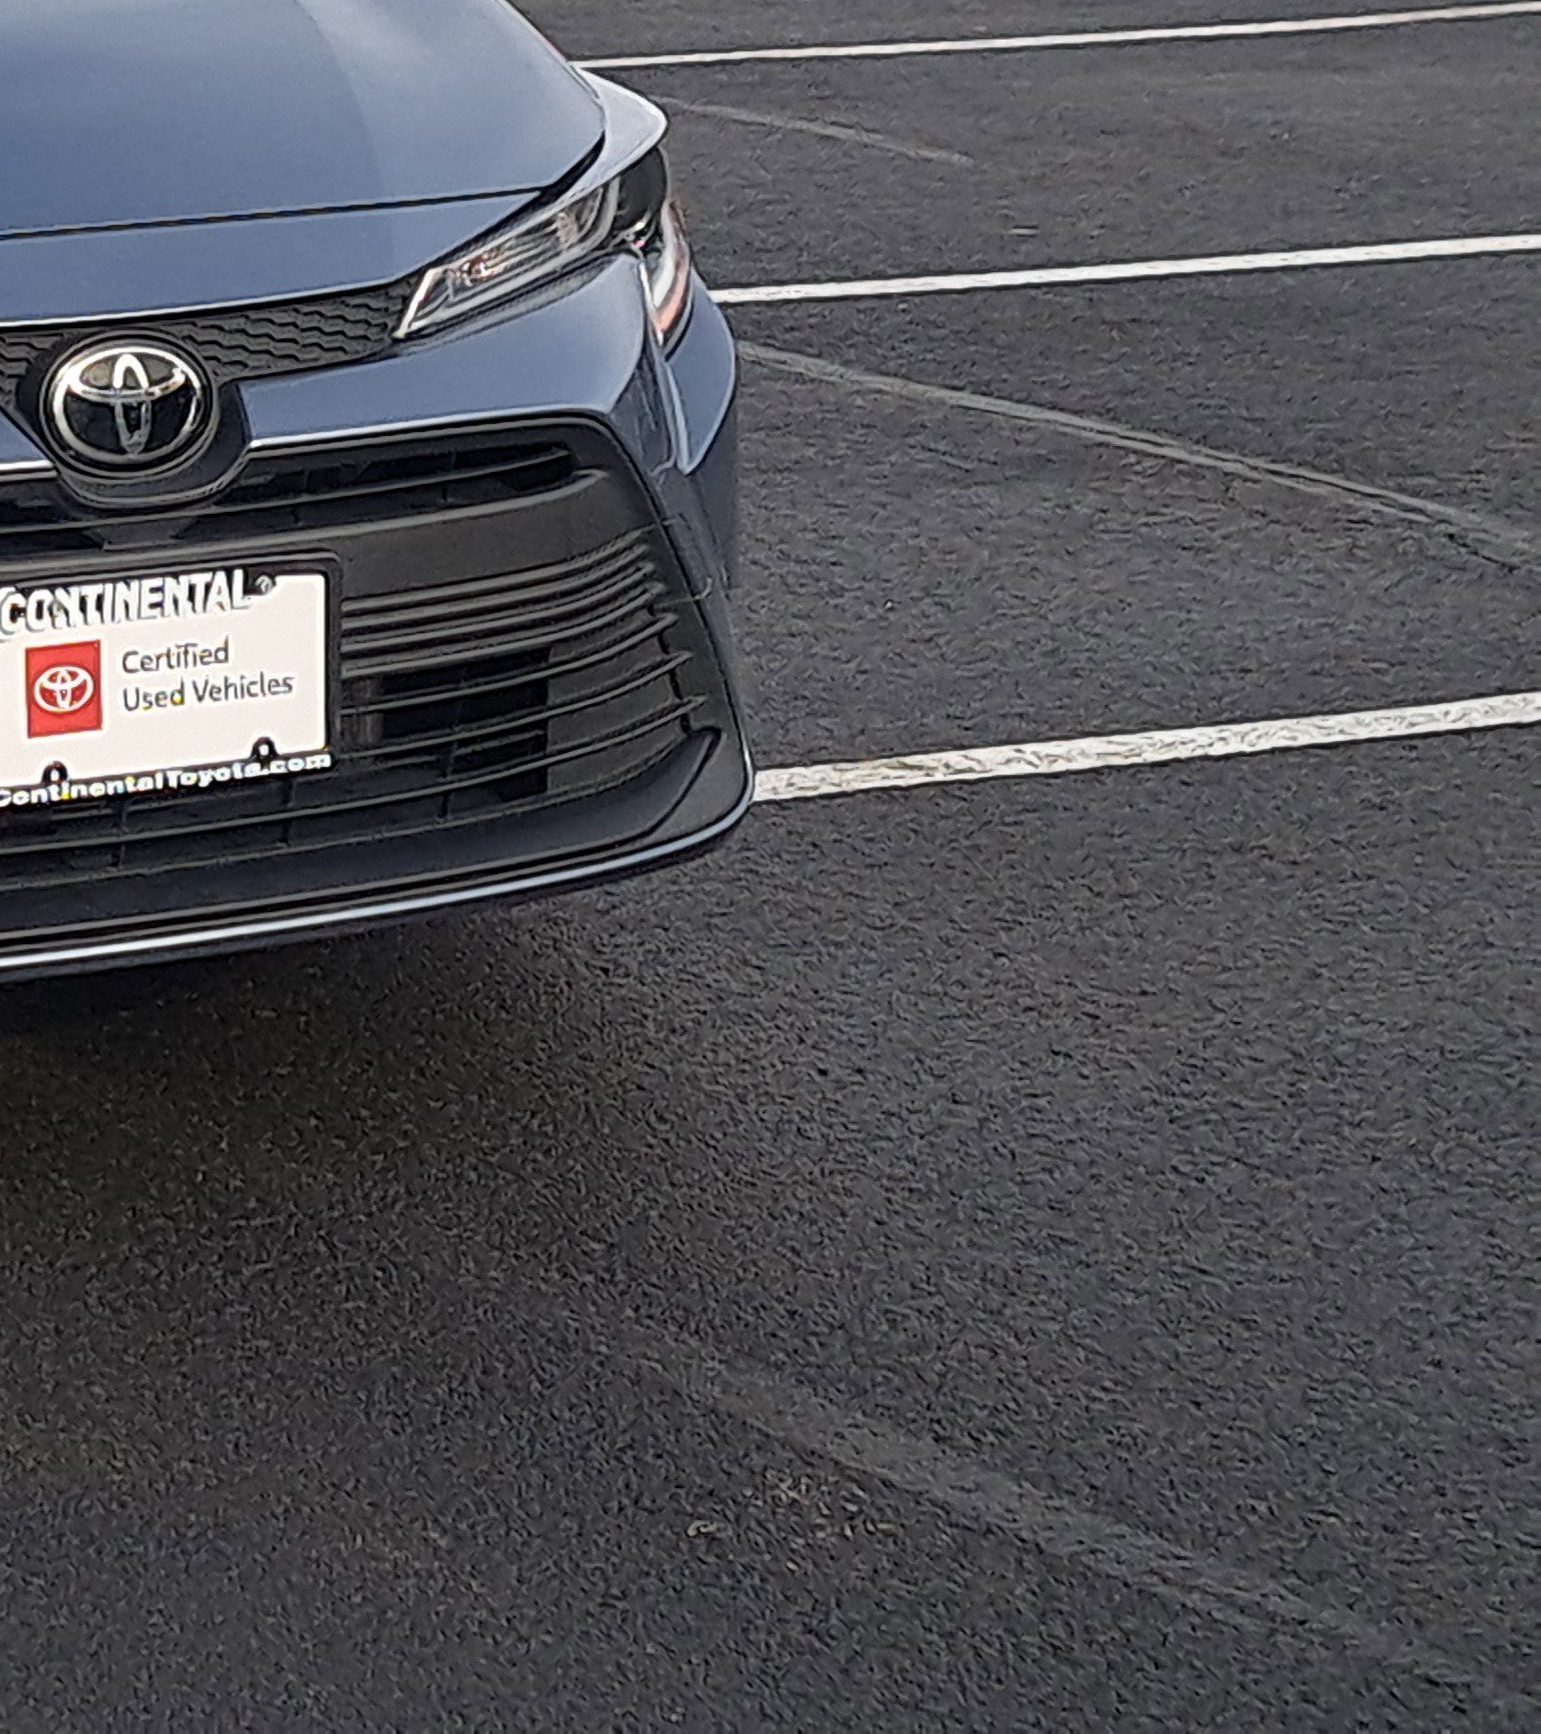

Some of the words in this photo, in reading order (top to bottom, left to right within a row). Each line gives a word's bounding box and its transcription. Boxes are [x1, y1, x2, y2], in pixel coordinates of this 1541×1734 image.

[121, 635, 230, 674] Certified
[122, 678, 186, 712] Used
[193, 671, 294, 705] Vehicles
